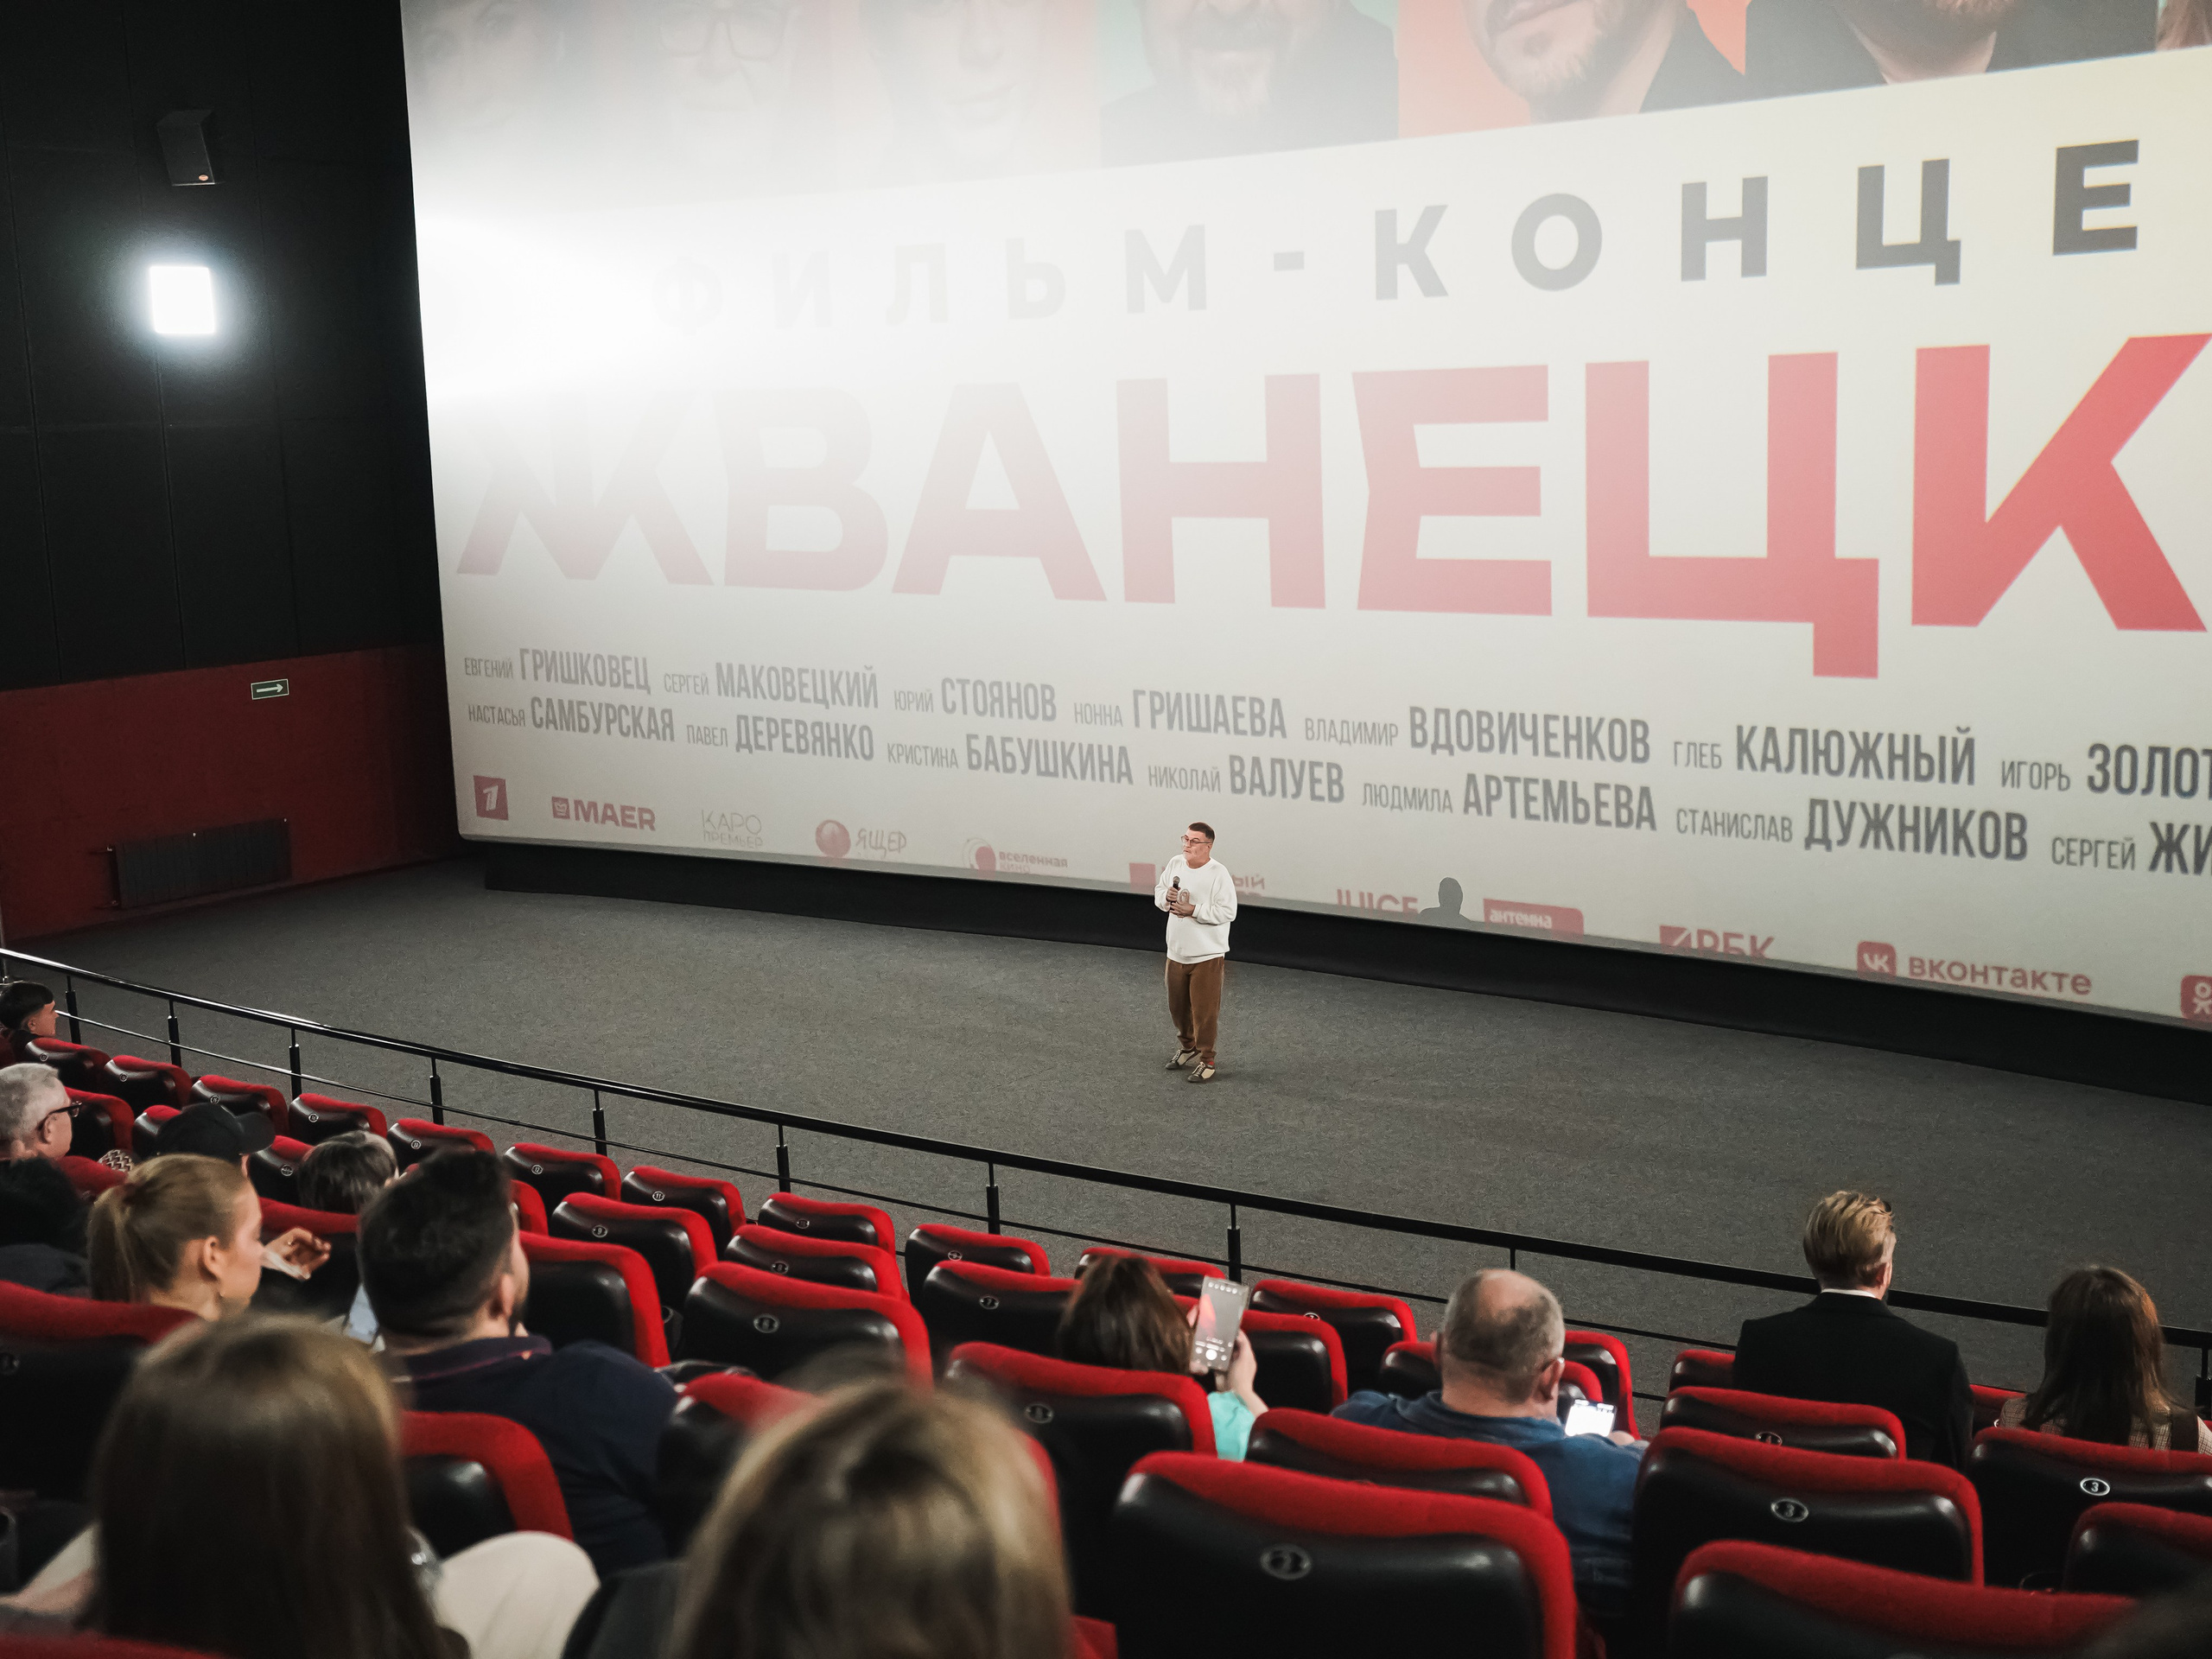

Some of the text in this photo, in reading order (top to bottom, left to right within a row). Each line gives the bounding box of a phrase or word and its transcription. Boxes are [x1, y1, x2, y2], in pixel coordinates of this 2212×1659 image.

[455, 333, 2212, 679] ЖВАНЕЦК
[464, 657, 513, 679] ЕВГЕНИЙ
[518, 648, 651, 694] ГРИШКОВЕЦ
[664, 672, 709, 696] СЕРГЕЙ
[715, 662, 879, 709] МАКОВЕЦКИЙ
[894, 688, 934, 713] ЮРИЙ
[941, 677, 1057, 722] СТОЯНОВ
[1074, 702, 1123, 728] НОННА
[1132, 689, 1287, 739] ГРИШАЕВА
[1304, 717, 1399, 747] ВЛАДИМИР
[1409, 706, 1650, 765] ВДОВИЧЕНКОВ
[1673, 741, 1722, 770] ГЛЕБ
[1736, 724, 1976, 786] КАЛЮЖНЫЙ
[2001, 760, 2071, 792] ИГОРЬ
[467, 704, 526, 728] НАСТАСЬЯ
[531, 696, 675, 743] САМБУРСКАЯ
[687, 724, 728, 747] ПАВЕЛ
[734, 714, 874, 762] ДЕРЕВЯНКО
[887, 741, 959, 770] КРИСТИНА
[966, 733, 1134, 785] БАБУШКИНА
[1148, 765, 1221, 794] НИКОЛАЙ
[1230, 754, 1344, 804] ВАЛУЕВ
[1362, 782, 1453, 814] ЛЮДМИЛА
[1463, 772, 1657, 831] АРТЕМЬЕВА
[1675, 808, 1793, 843] СТАНИСЛАВ
[1804, 798, 2028, 861] ДУЖНИКОВ
[2051, 836, 2136, 871] СЕРГЕЙ
[573, 799, 656, 831] MAER
[701, 810, 762, 835] КАРО
[702, 830, 764, 849] ПРЕМЬЕР
